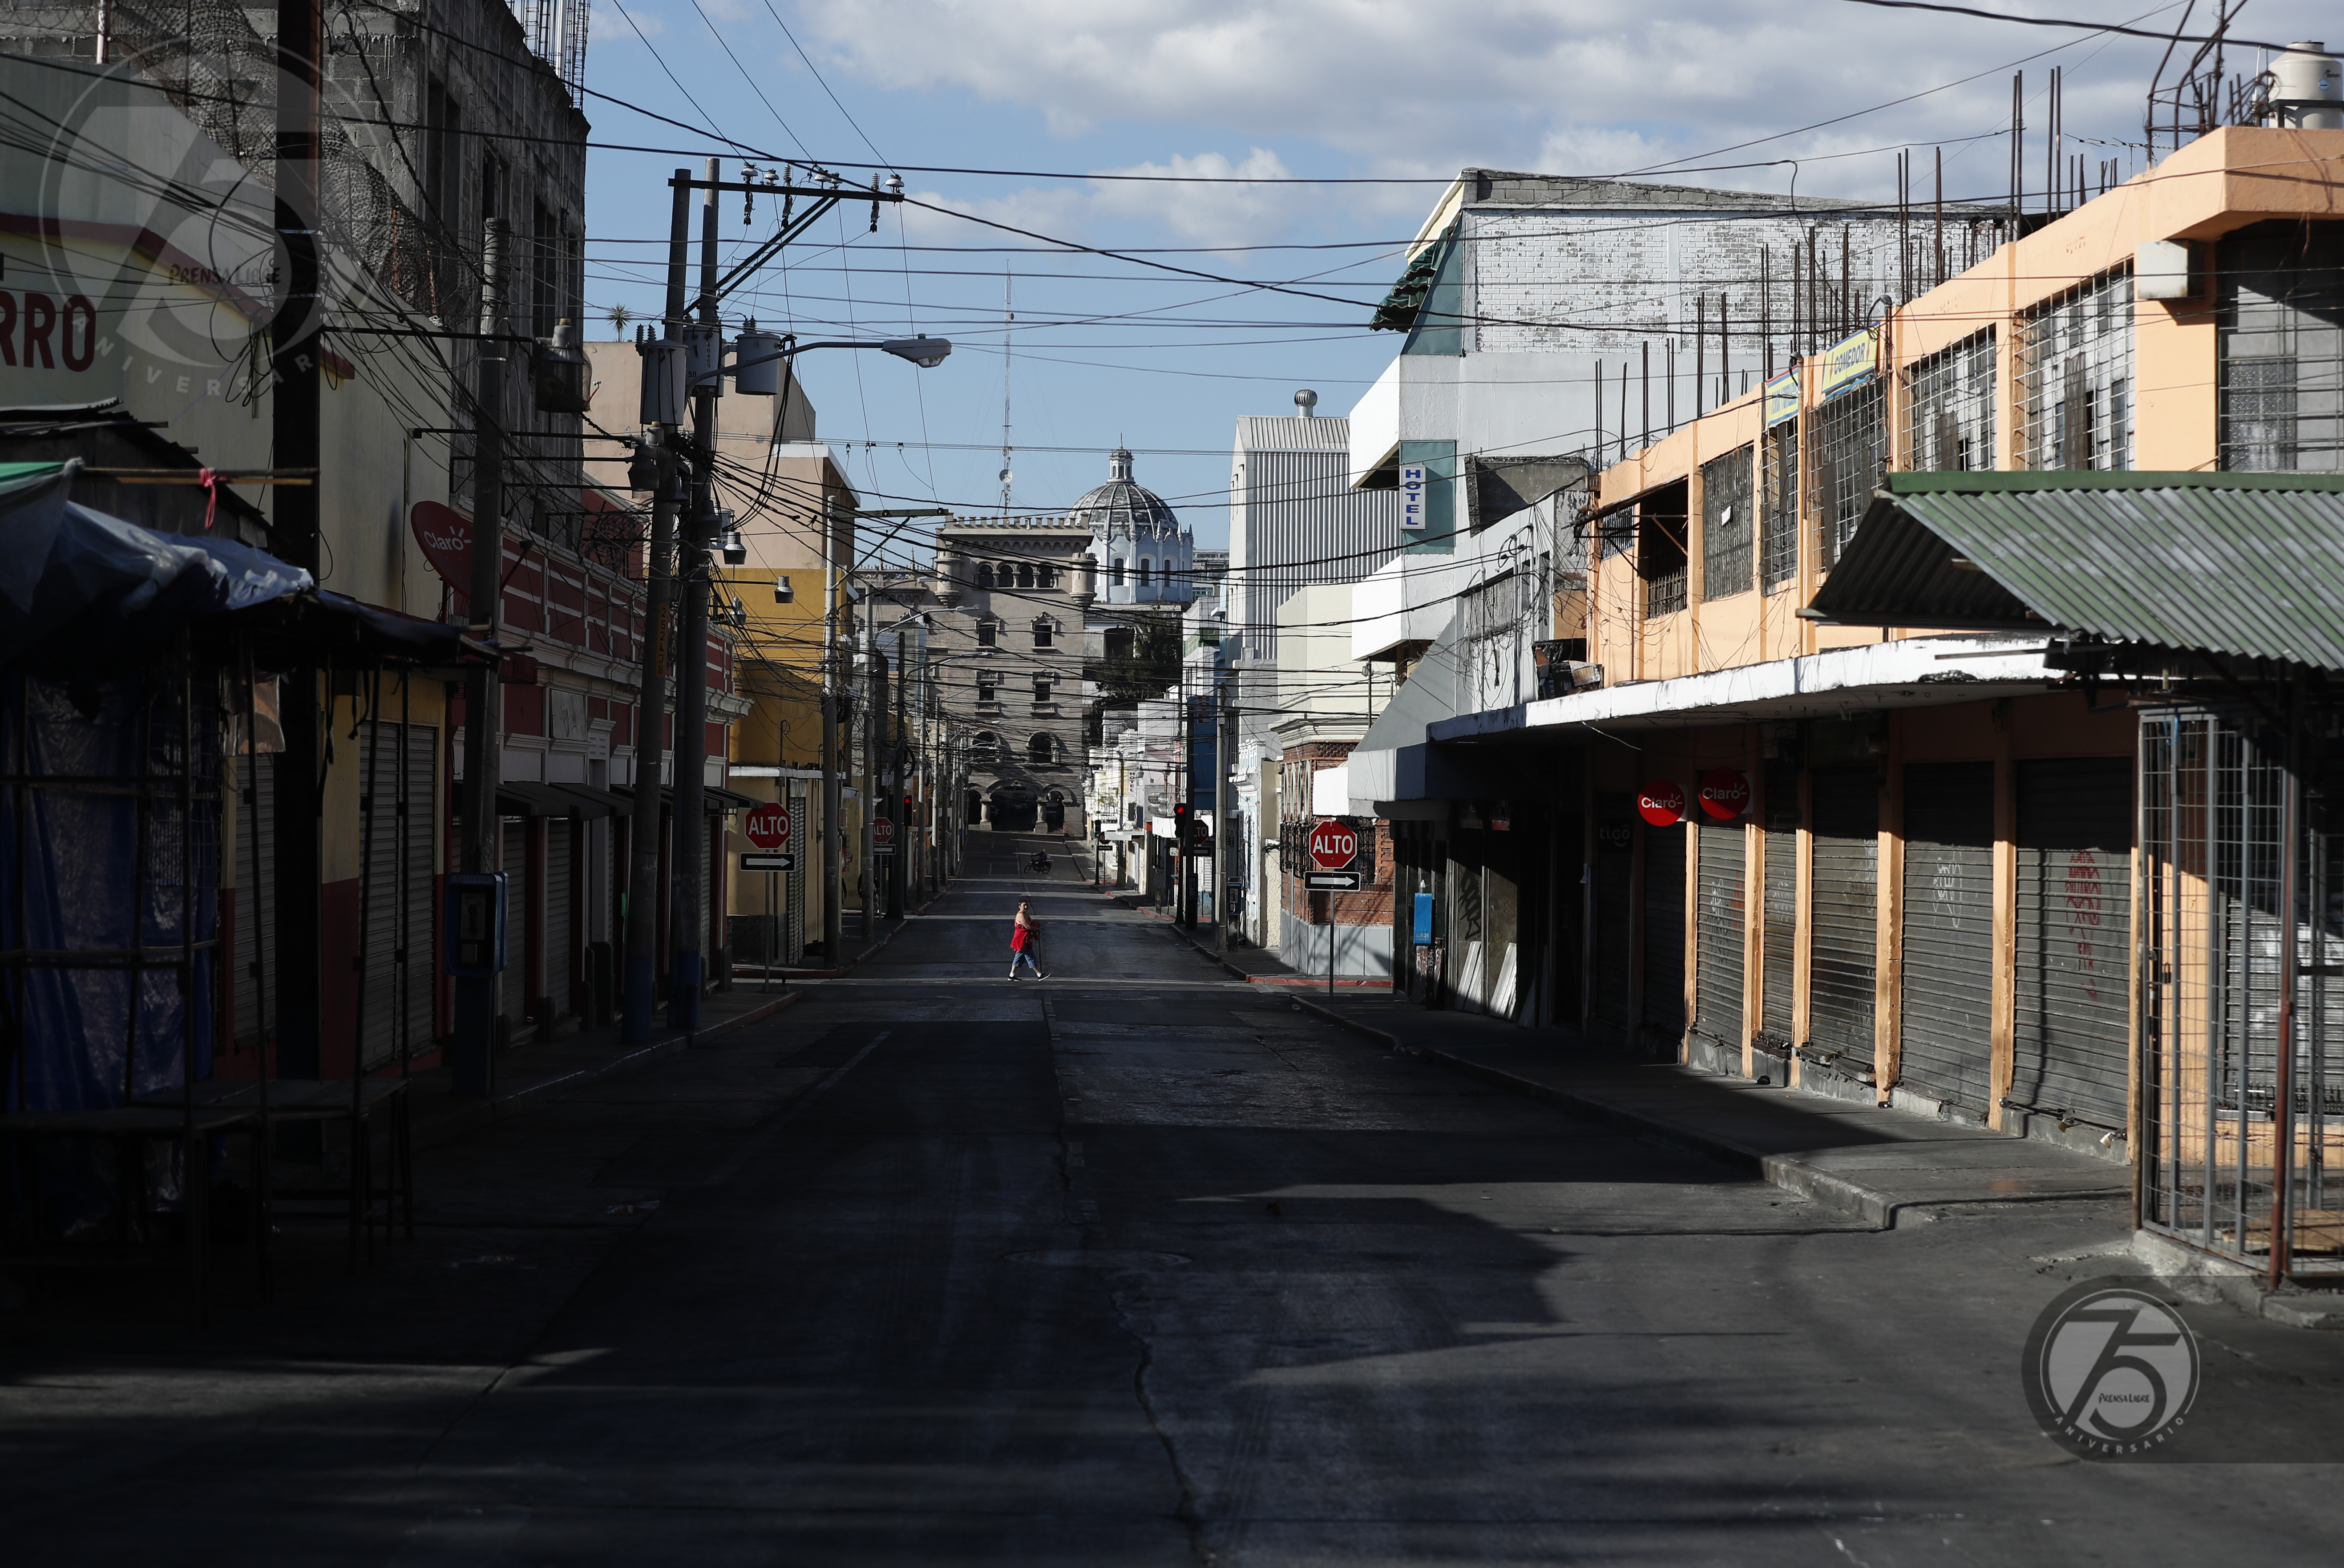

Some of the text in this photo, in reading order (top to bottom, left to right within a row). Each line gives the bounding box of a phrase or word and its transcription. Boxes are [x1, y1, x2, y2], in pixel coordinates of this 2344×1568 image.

[1834, 342, 1865, 375] COMEDOR
[1405, 469, 1421, 525] HOTEL
[423, 530, 464, 551] Claro
[658, 607, 667, 675] 252438
[1641, 796, 1677, 808] Claro
[1702, 787, 1741, 800] Claro
[748, 816, 789, 835] ALTO
[1312, 835, 1354, 854] ALTO
